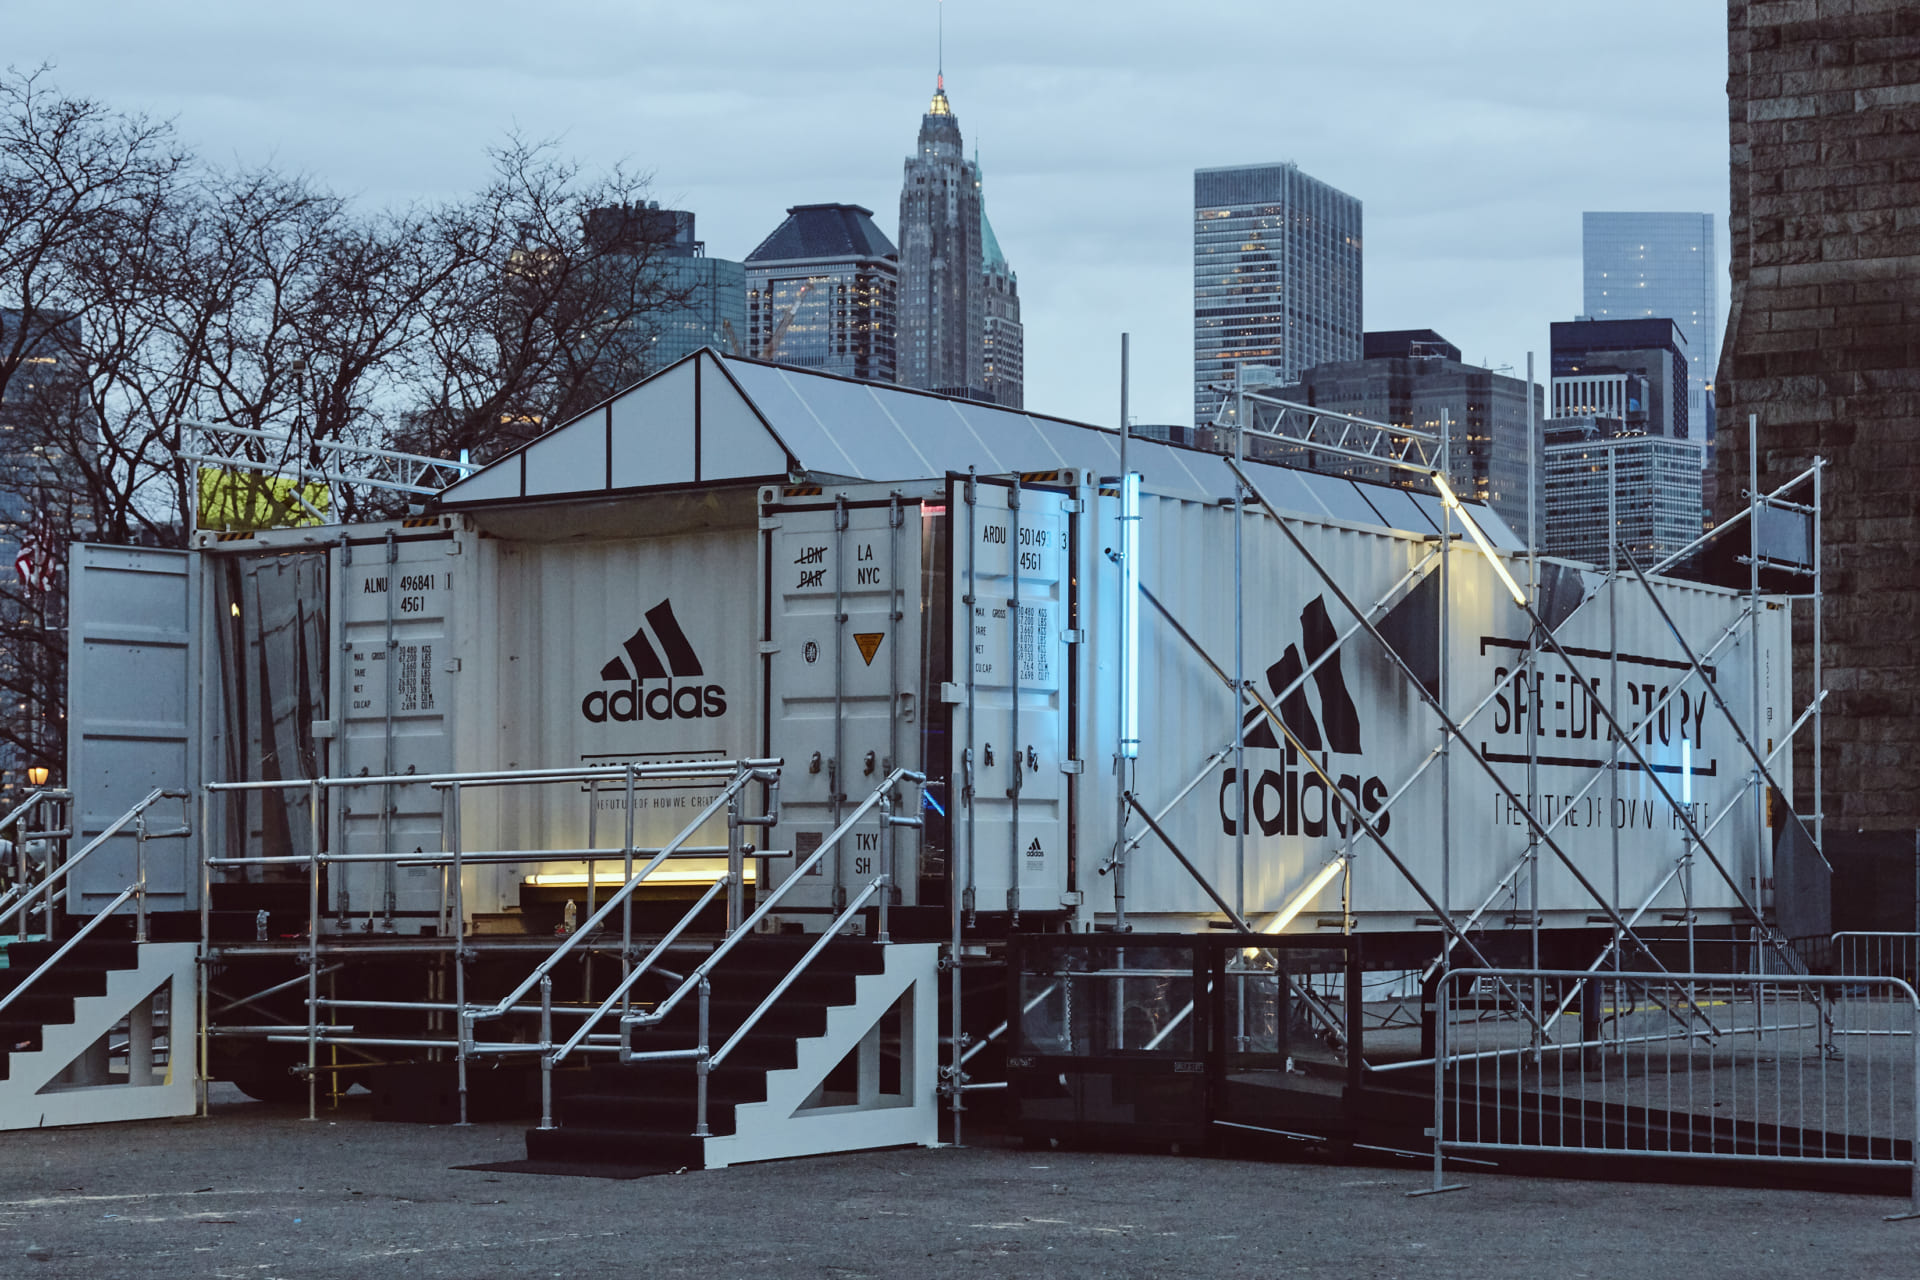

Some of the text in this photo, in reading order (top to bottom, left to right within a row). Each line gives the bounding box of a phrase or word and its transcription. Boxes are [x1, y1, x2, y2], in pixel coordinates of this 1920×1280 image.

[982, 525, 1006, 544] ARDU
[1061, 532, 1068, 550] 3
[799, 546, 824, 564] LDN
[857, 543, 873, 561] LA
[1019, 552, 1041, 571] 45G1
[364, 577, 388, 593] ALNU
[400, 574, 434, 591] 496841
[799, 570, 823, 588] PAR
[857, 567, 880, 585] NYC
[401, 596, 424, 612] 45G1
[975, 645, 984, 654] NET
[582, 677, 727, 723] adidas
[1220, 748, 1390, 839] adidas
[605, 799, 637, 810] FUTUE
[673, 797, 686, 807] WE
[855, 833, 879, 851] TKY
[855, 857, 871, 874] SH
